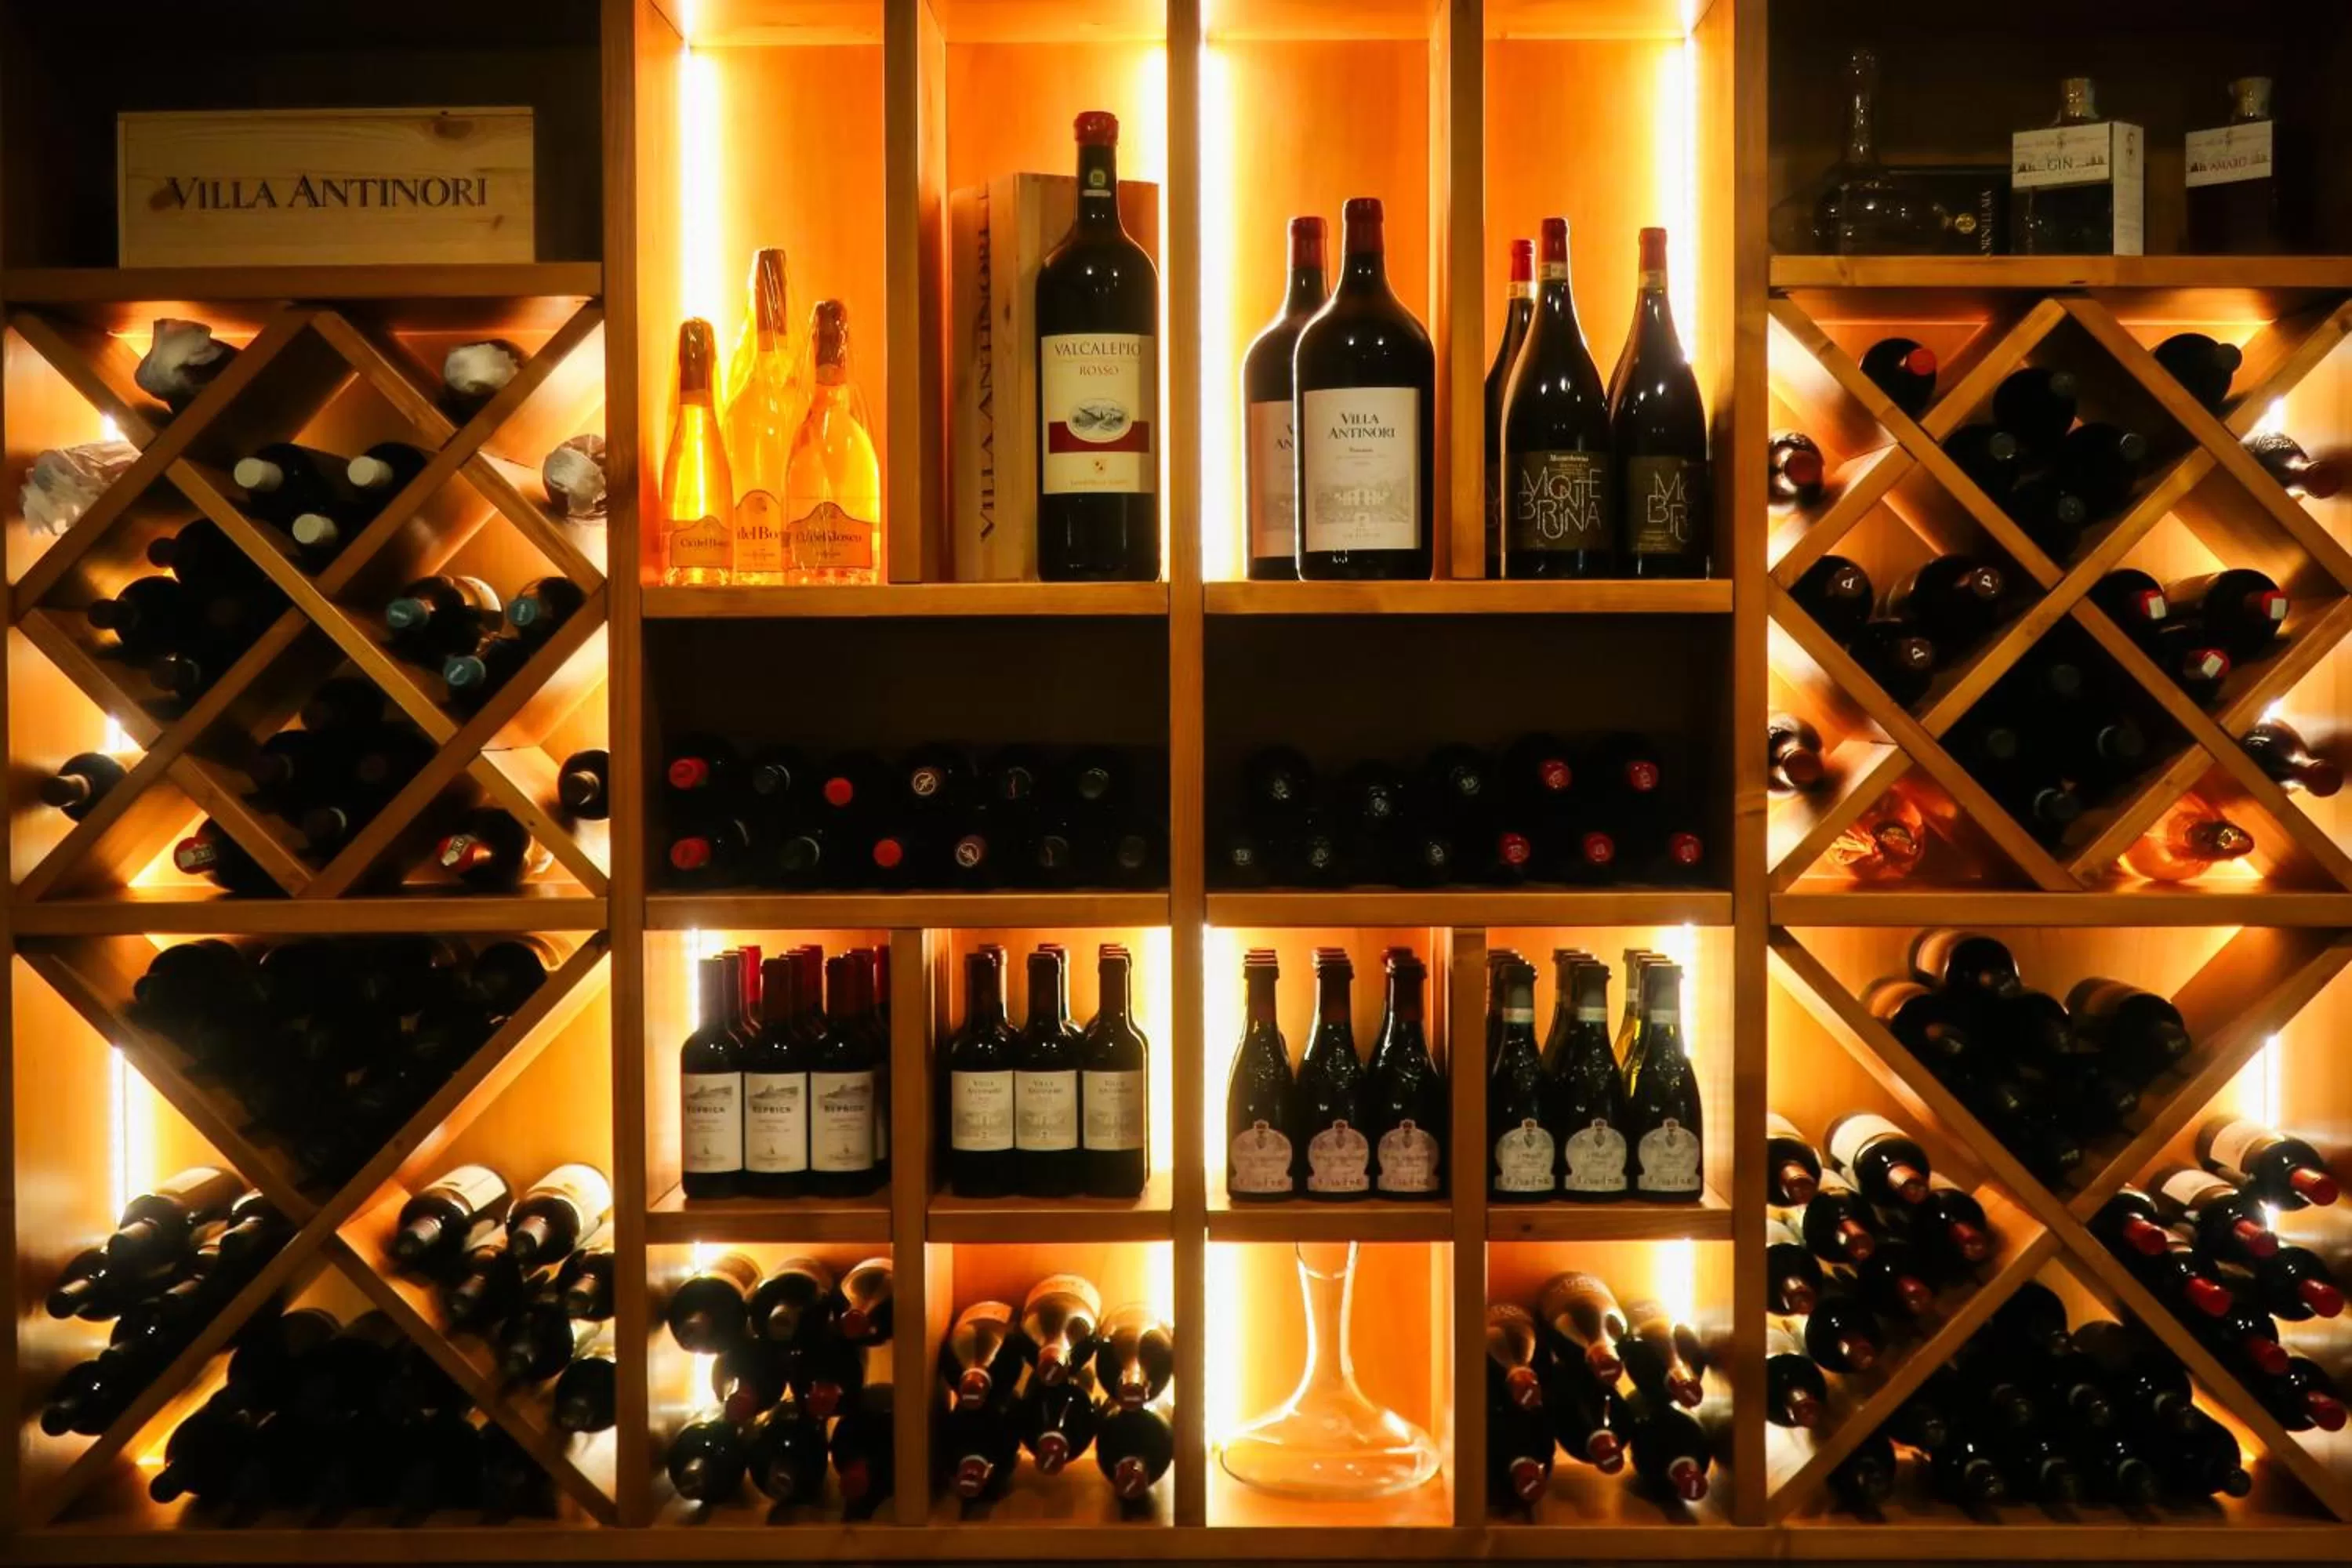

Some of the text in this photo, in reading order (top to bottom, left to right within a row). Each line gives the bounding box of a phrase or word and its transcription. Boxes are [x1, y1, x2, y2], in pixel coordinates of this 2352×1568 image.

[2047, 156, 2074, 171] GIN
[165, 173, 488, 210] VILLA ANTINORI
[1054, 341, 1142, 357] VALCALEPIO
[1079, 365, 1120, 376] ROSSO
[1341, 412, 1380, 425] VILLA
[1327, 426, 1396, 440] ANTINORI
[978, 431, 995, 543] VILLA
